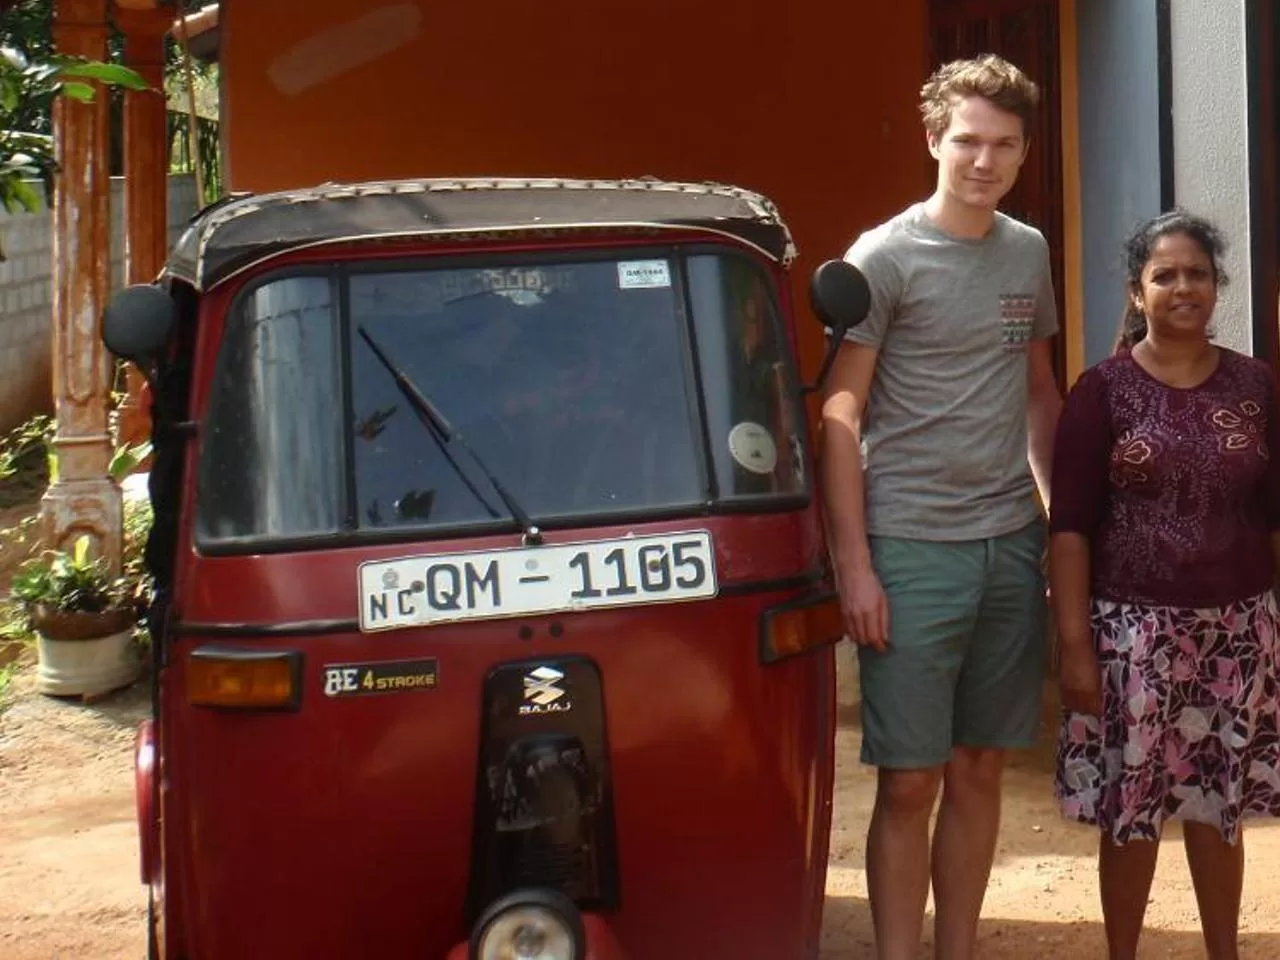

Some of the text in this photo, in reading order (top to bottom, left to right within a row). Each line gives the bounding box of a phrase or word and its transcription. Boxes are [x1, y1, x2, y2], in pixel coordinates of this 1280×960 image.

[427, 560, 501, 611] QM
[363, 669, 375, 689] 4
[376, 673, 435, 690] STROKE
